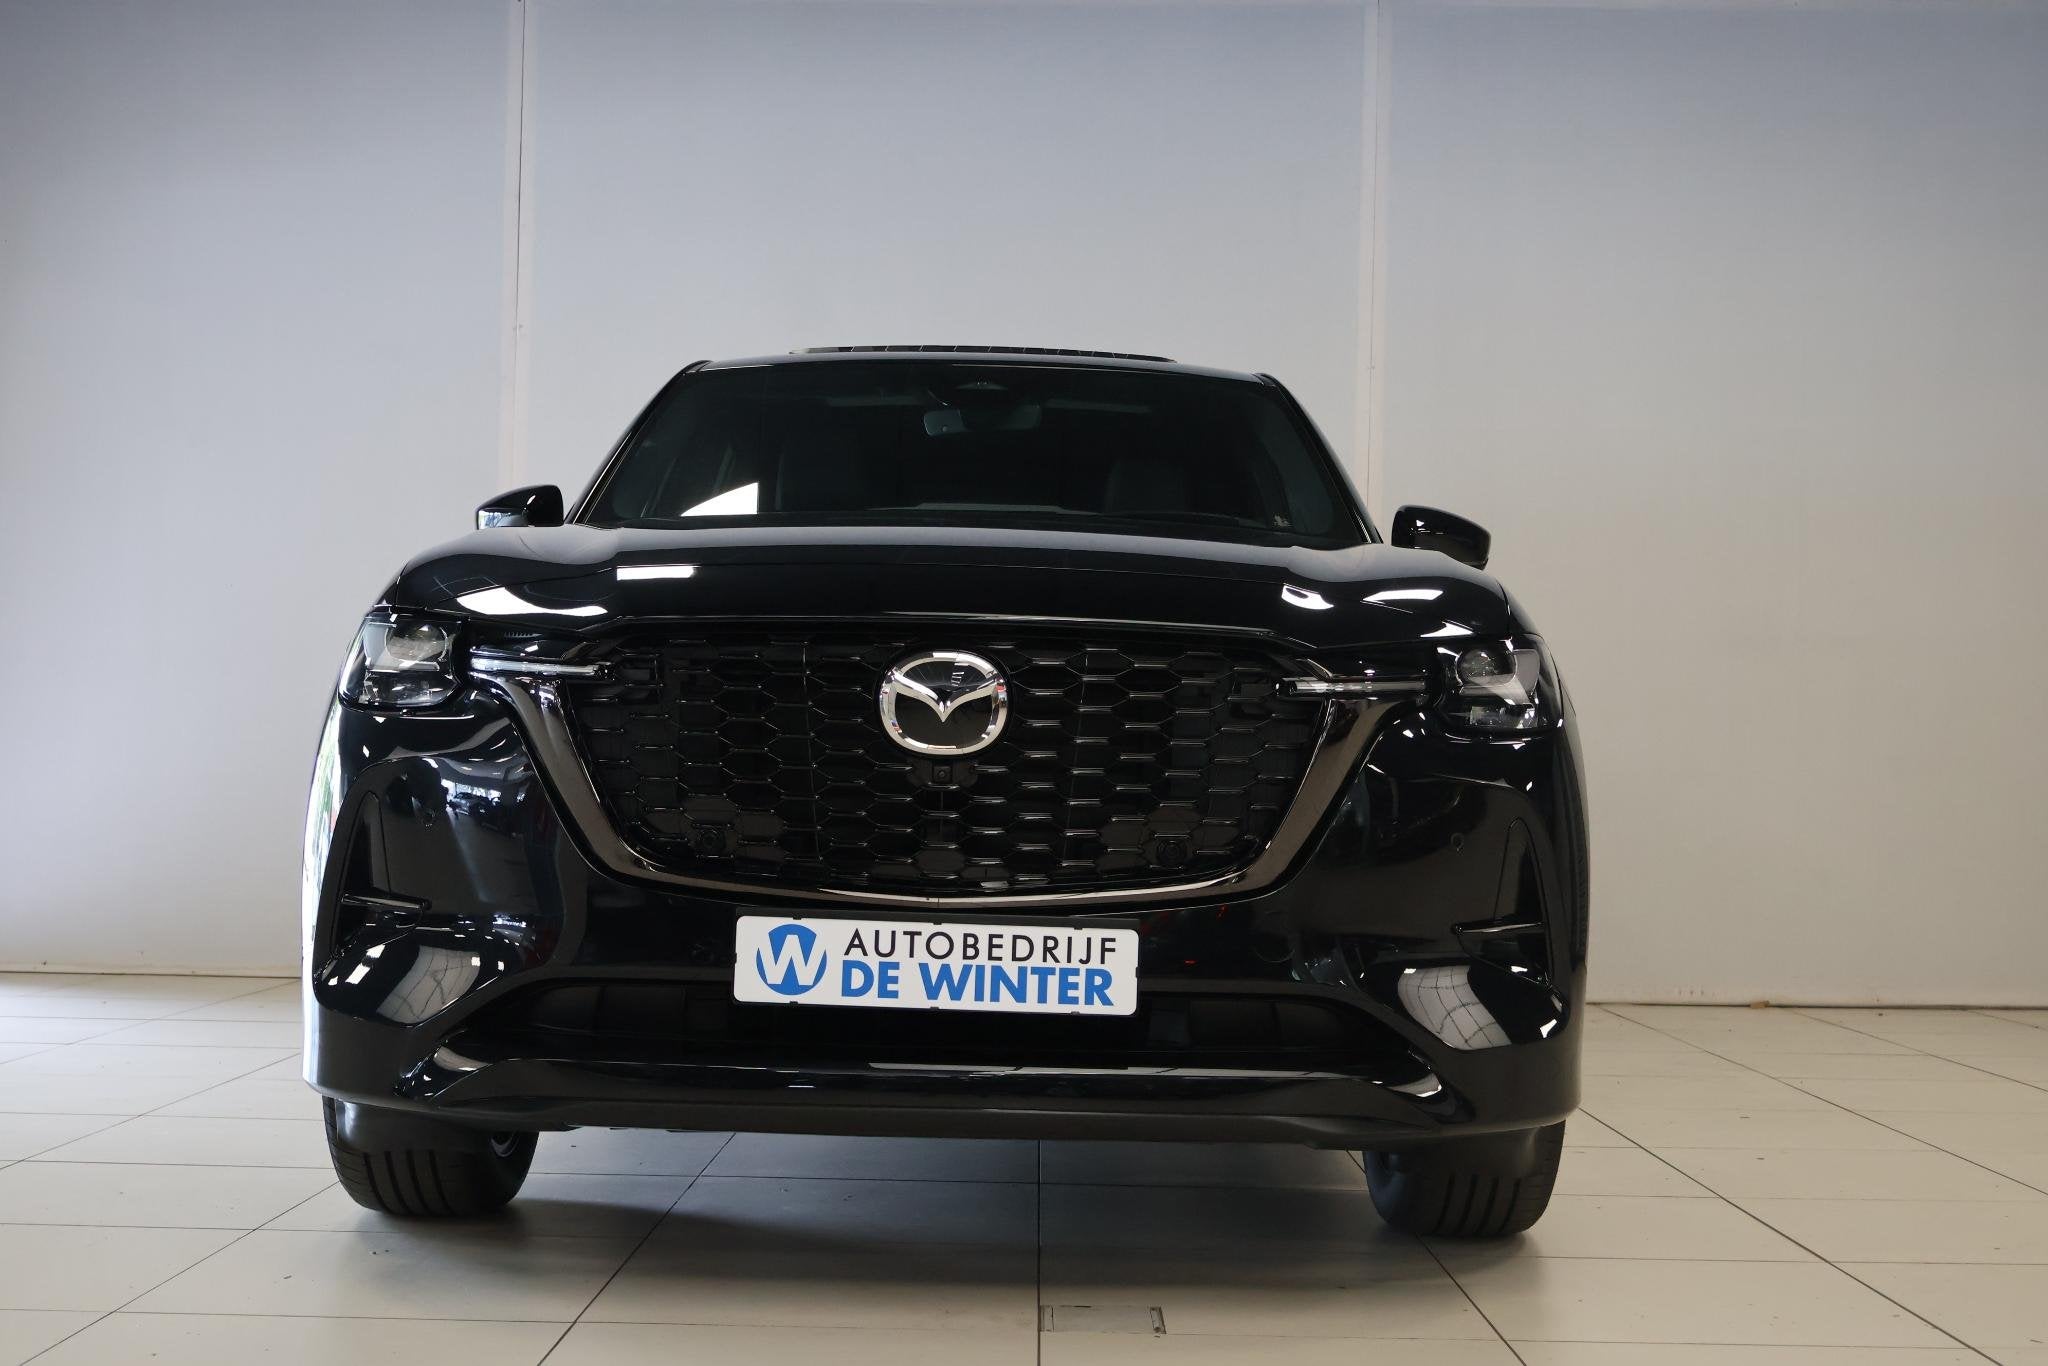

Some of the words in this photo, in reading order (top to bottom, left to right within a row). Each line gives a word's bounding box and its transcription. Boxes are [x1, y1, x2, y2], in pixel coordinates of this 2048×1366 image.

[844, 928, 1117, 965] AUTOBEDRIJF
[841, 960, 899, 999] DE
[918, 963, 1114, 1006] WINTER
